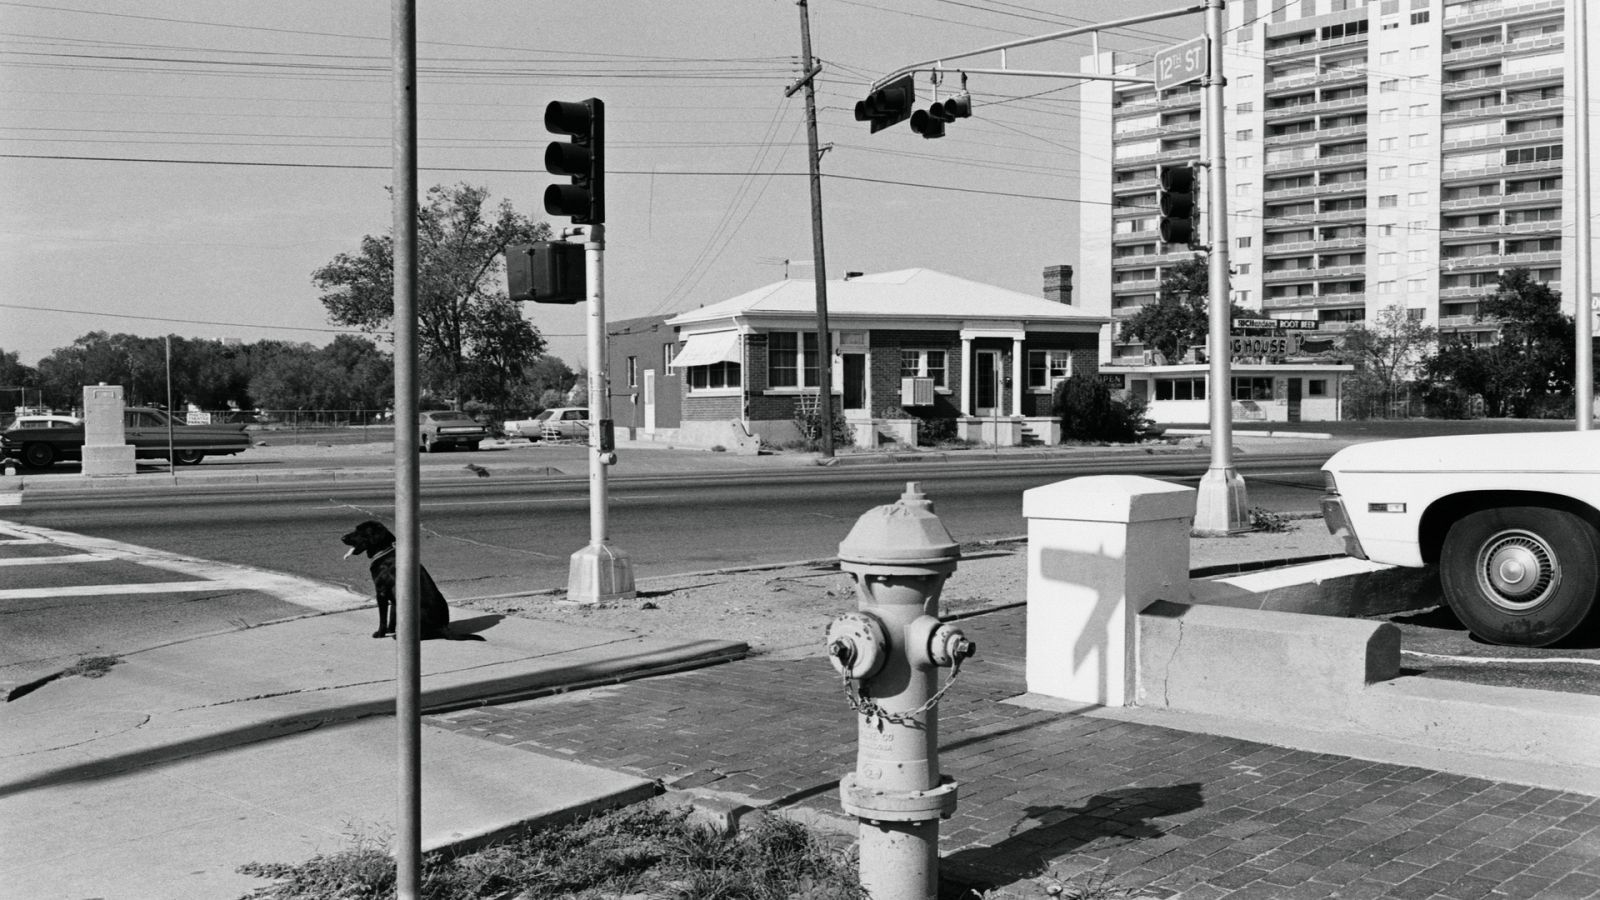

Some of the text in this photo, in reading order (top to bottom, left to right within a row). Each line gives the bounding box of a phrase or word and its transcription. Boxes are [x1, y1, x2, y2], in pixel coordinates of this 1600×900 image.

[1160, 47, 1202, 81] 12TH ST
[1279, 320, 1299, 329] ROOT
[1300, 320, 1316, 329] BEER
[1244, 339, 1286, 353] HOUSE
